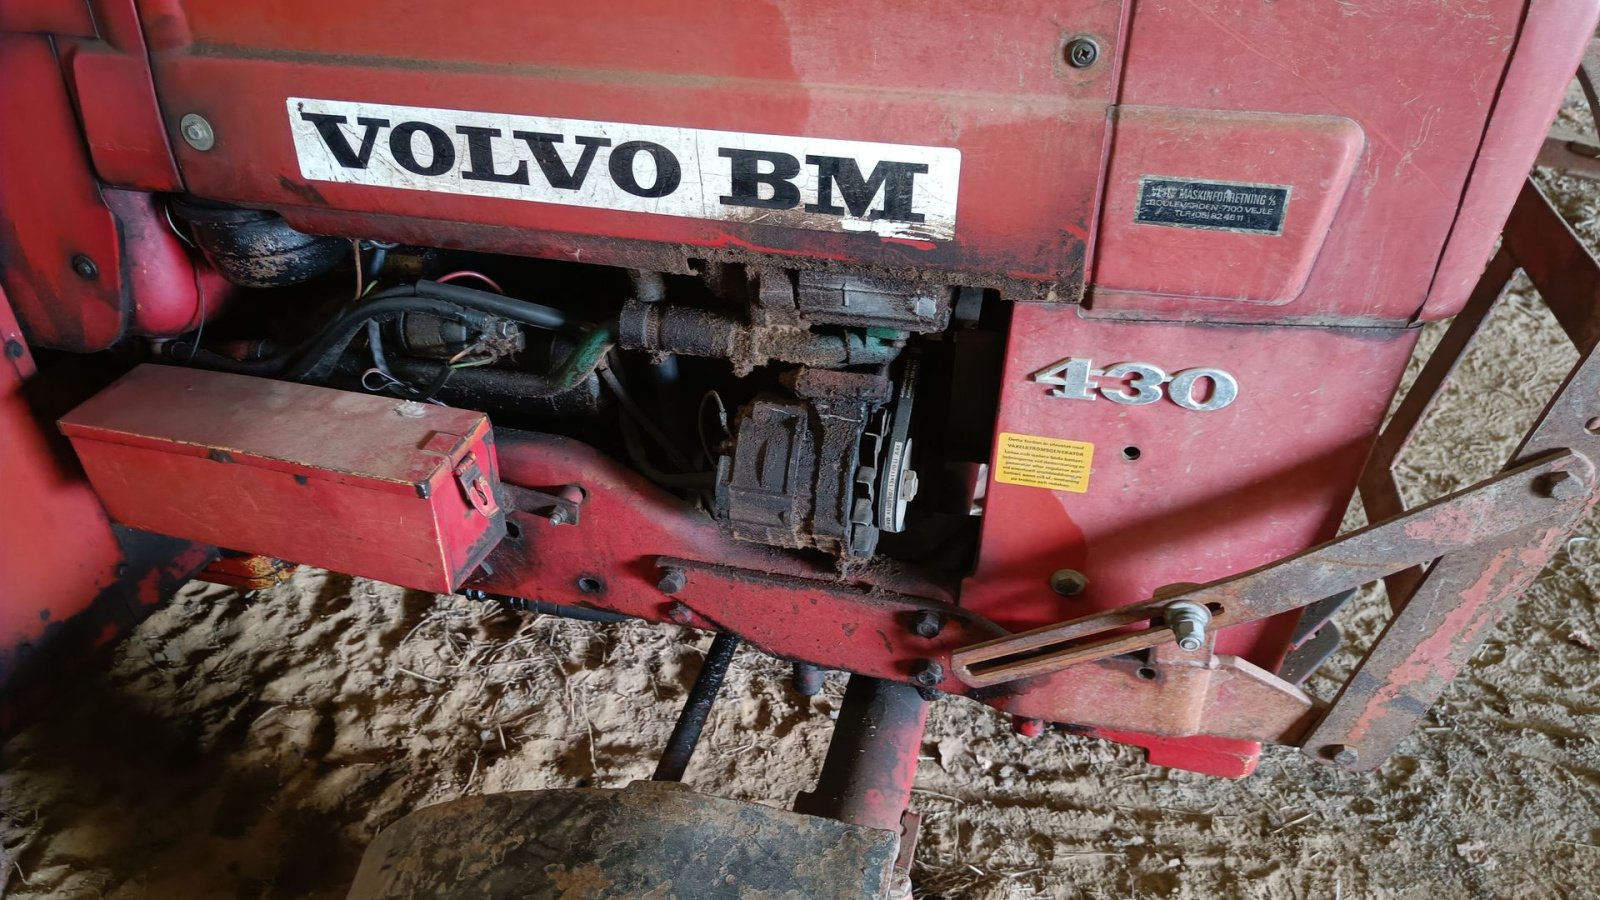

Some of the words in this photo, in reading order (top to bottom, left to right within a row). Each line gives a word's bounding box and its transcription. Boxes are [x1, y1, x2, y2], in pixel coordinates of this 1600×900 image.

[301, 111, 682, 199] VOLVO
[719, 147, 930, 223] BM
[1244, 206, 1273, 215] VEJLE
[1029, 356, 1239, 411] 430
